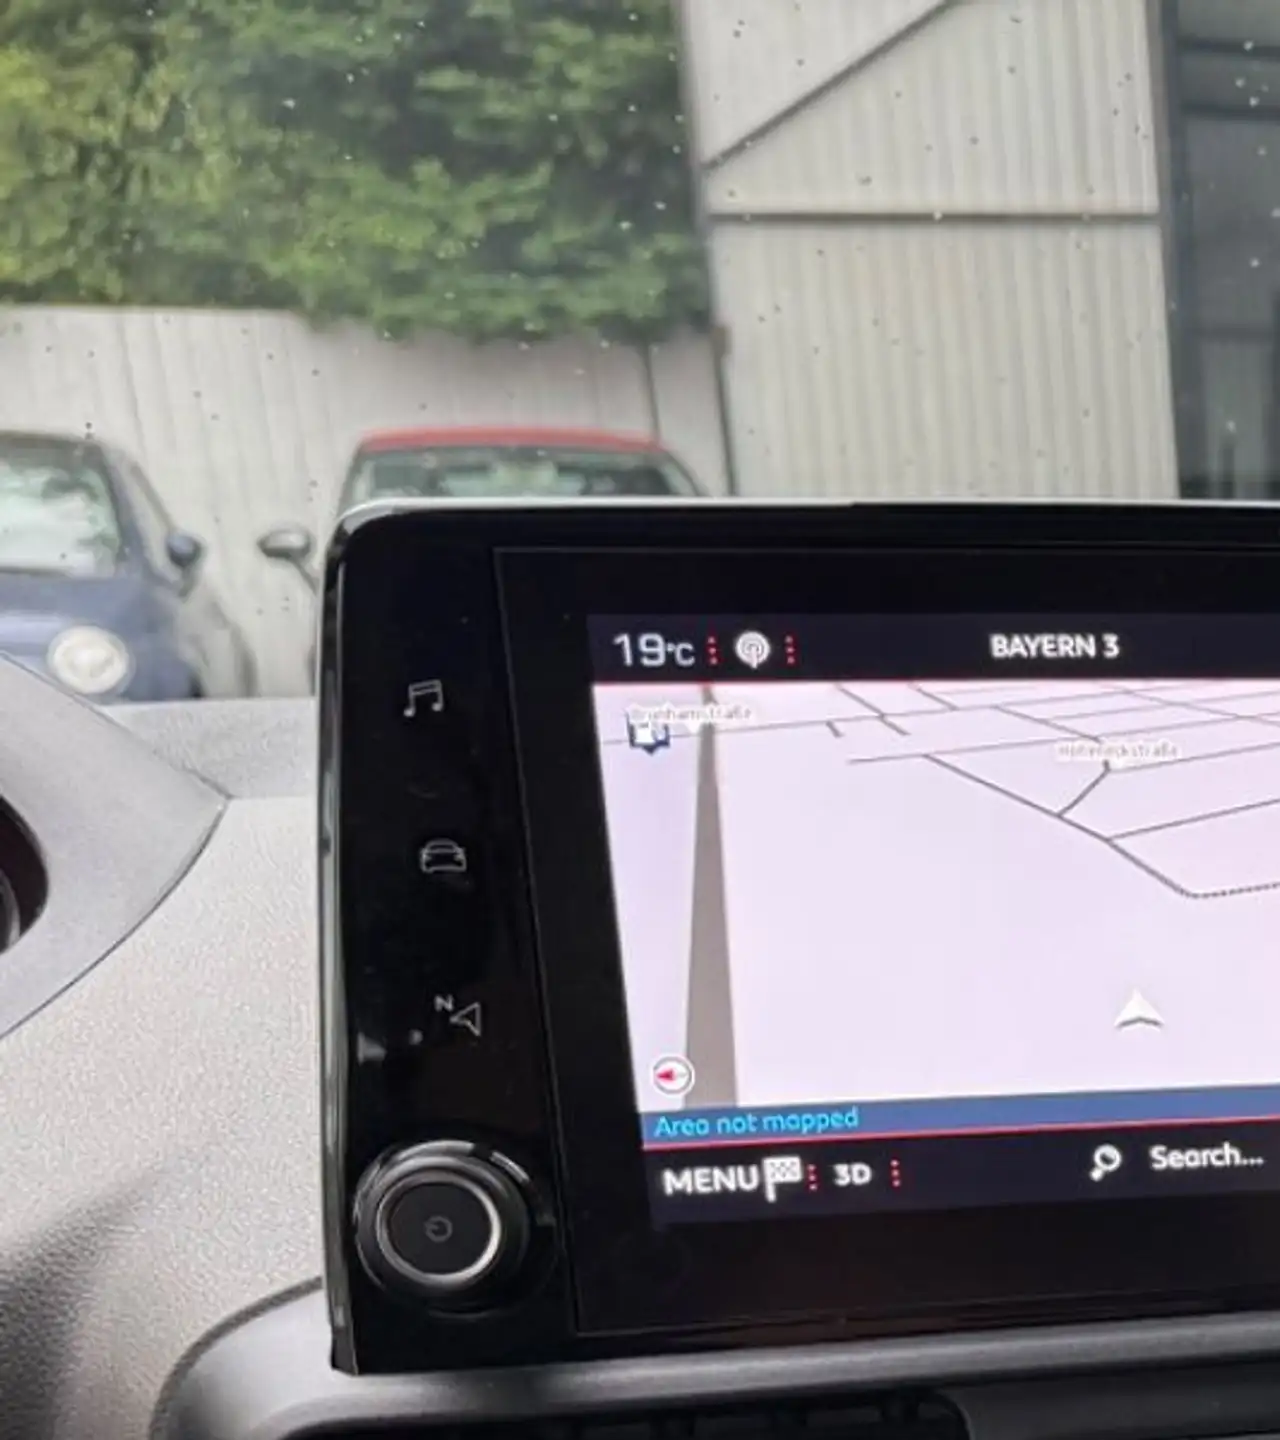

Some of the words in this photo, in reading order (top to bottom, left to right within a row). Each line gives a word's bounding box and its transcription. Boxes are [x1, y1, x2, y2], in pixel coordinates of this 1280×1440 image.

[991, 634, 1097, 660] BAYERN
[1102, 633, 1120, 660] 3
[654, 1115, 708, 1138] Area
[716, 1113, 759, 1135] not
[763, 1106, 860, 1138] mapped
[1149, 1142, 1265, 1171] Search...
[662, 1165, 760, 1197] MENU
[833, 1164, 872, 1187] 3D
